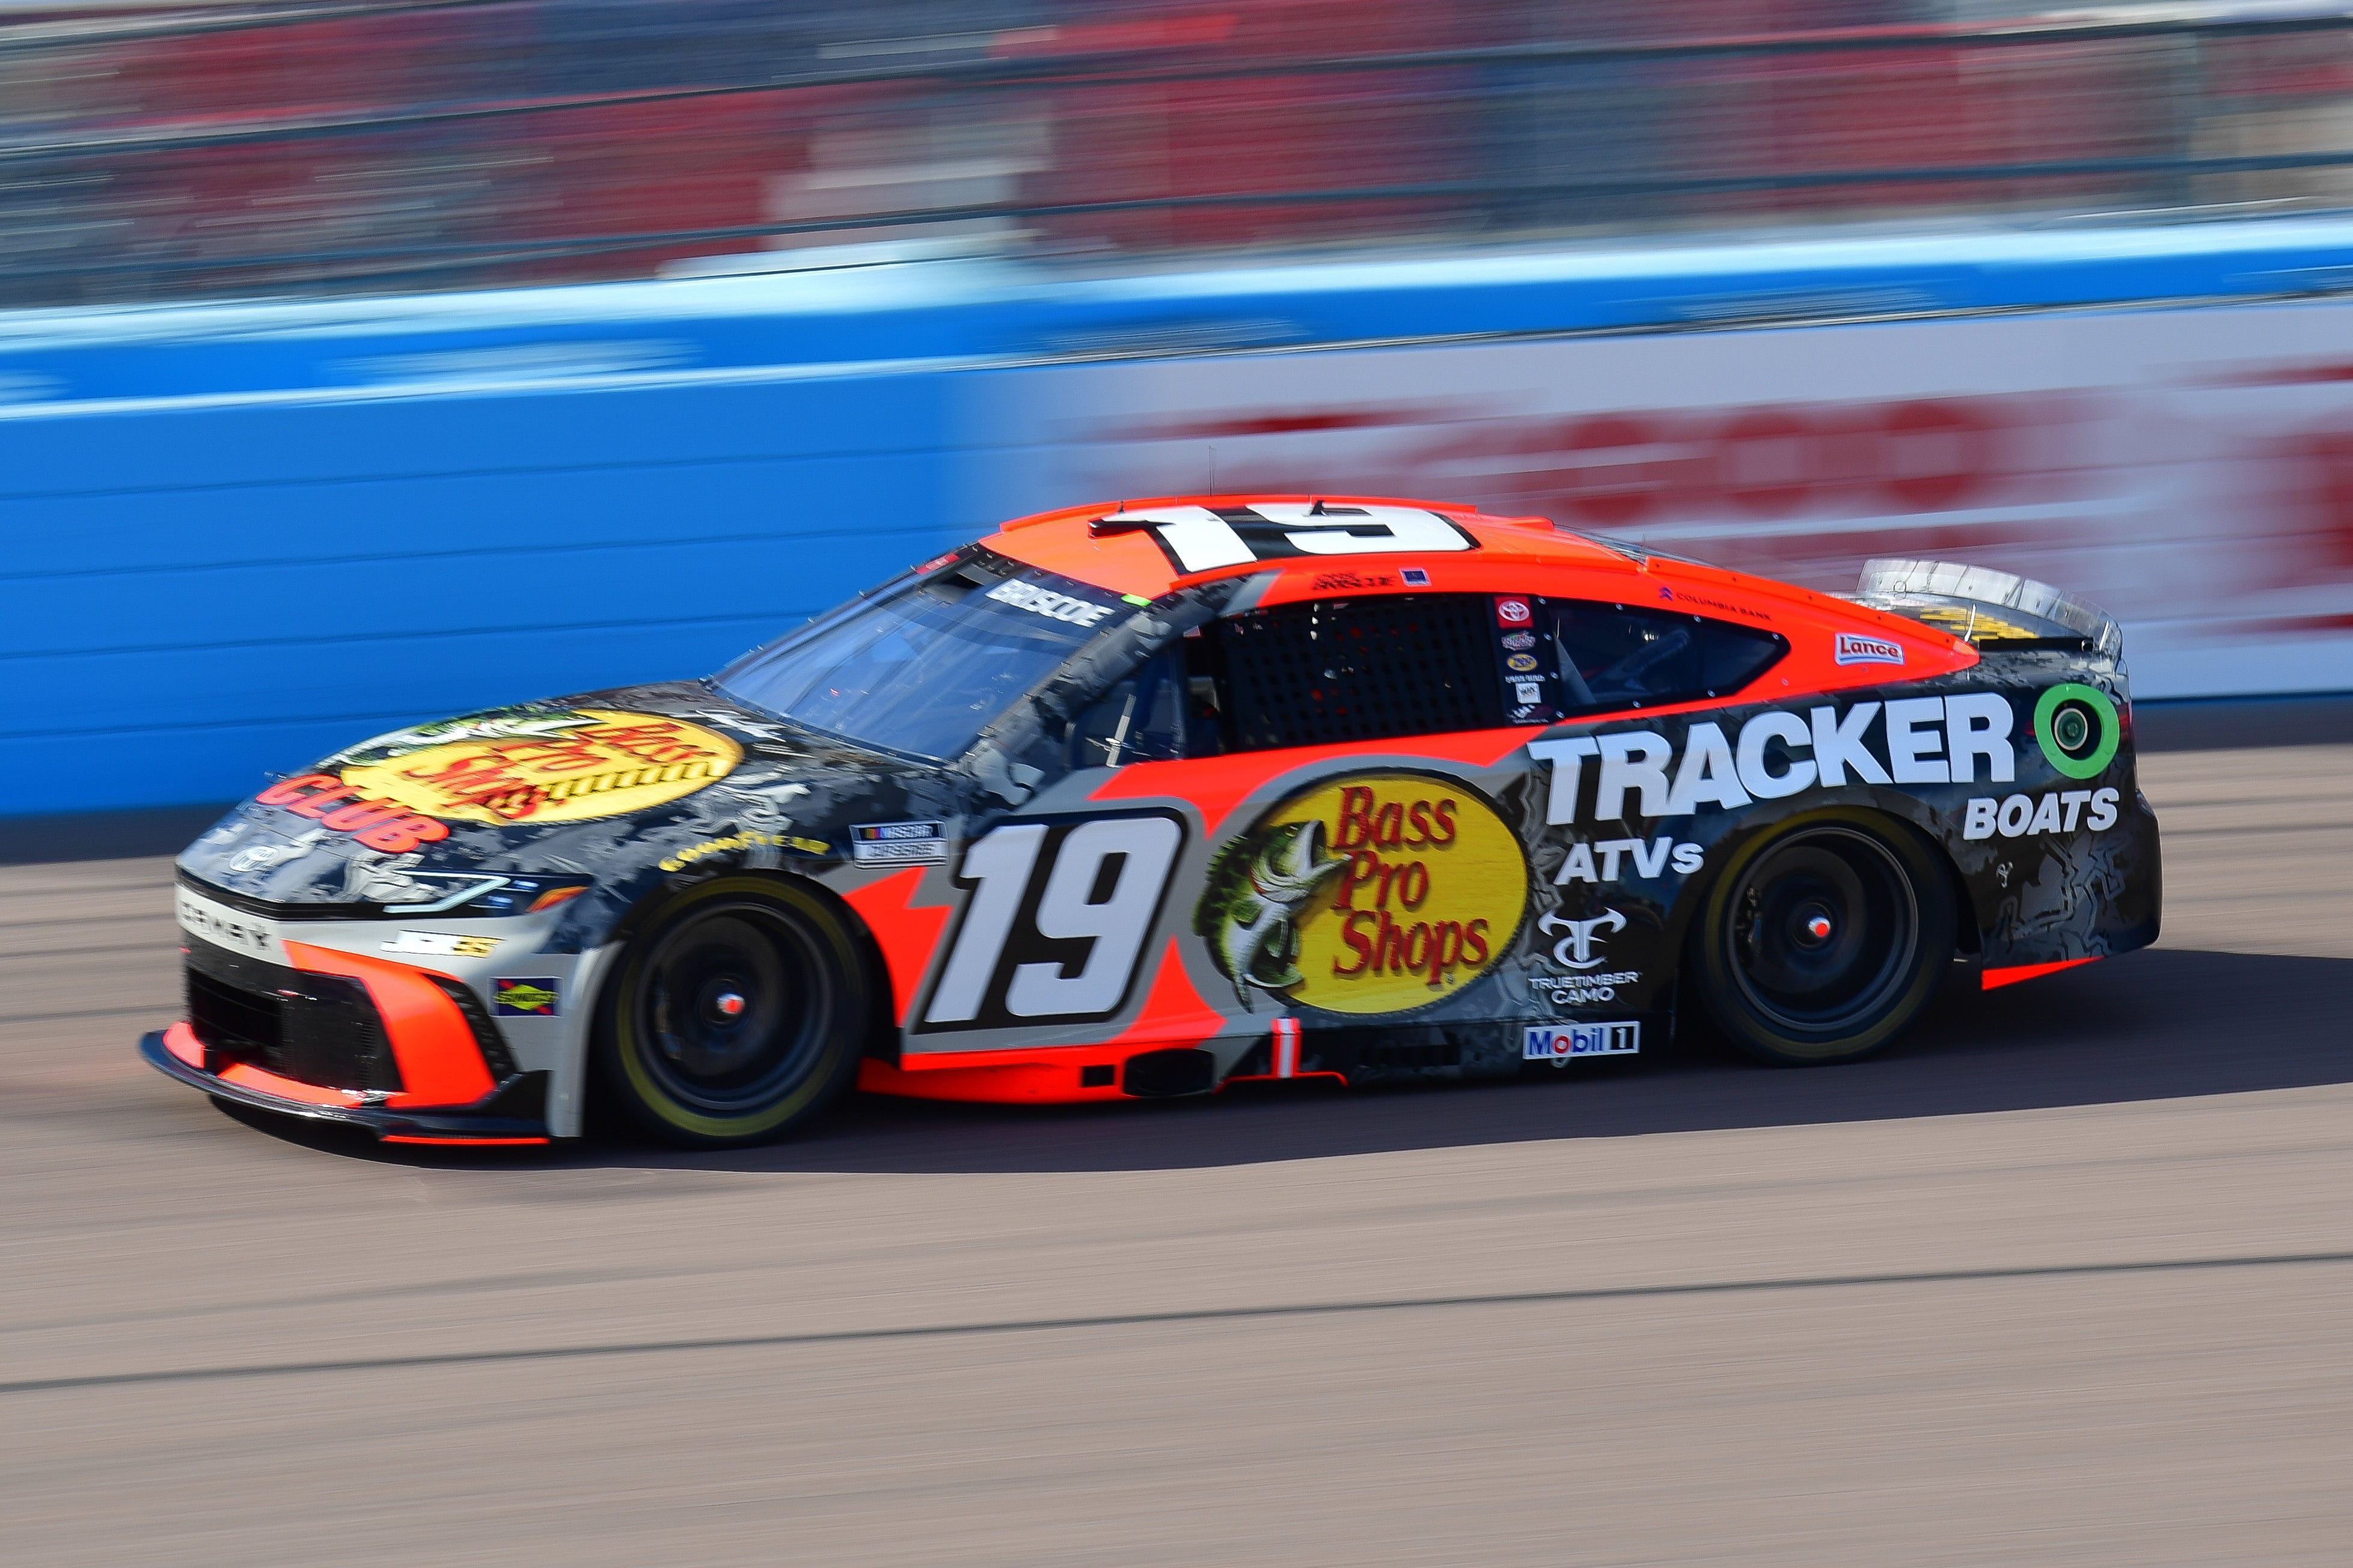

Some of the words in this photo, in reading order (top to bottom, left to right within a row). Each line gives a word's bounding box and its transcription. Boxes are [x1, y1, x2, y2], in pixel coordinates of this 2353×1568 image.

[1099, 504, 1470, 572] 19
[1840, 636, 1899, 658] Lance
[1528, 691, 2015, 826] TRACKER
[255, 773, 451, 853] CLUB
[1333, 786, 1458, 850] Bass
[1962, 786, 2120, 840] BOATS
[1332, 848, 1429, 911] Pro
[1555, 836, 1704, 886] ATVs
[923, 817, 1182, 1023] 19
[1333, 909, 1489, 987] Shops
[1528, 971, 1640, 990] TRUETIMBER
[1551, 986, 1615, 1005] CAMO
[1529, 1027, 1604, 1055] Mobil
[1616, 1027, 1627, 1049] 1
